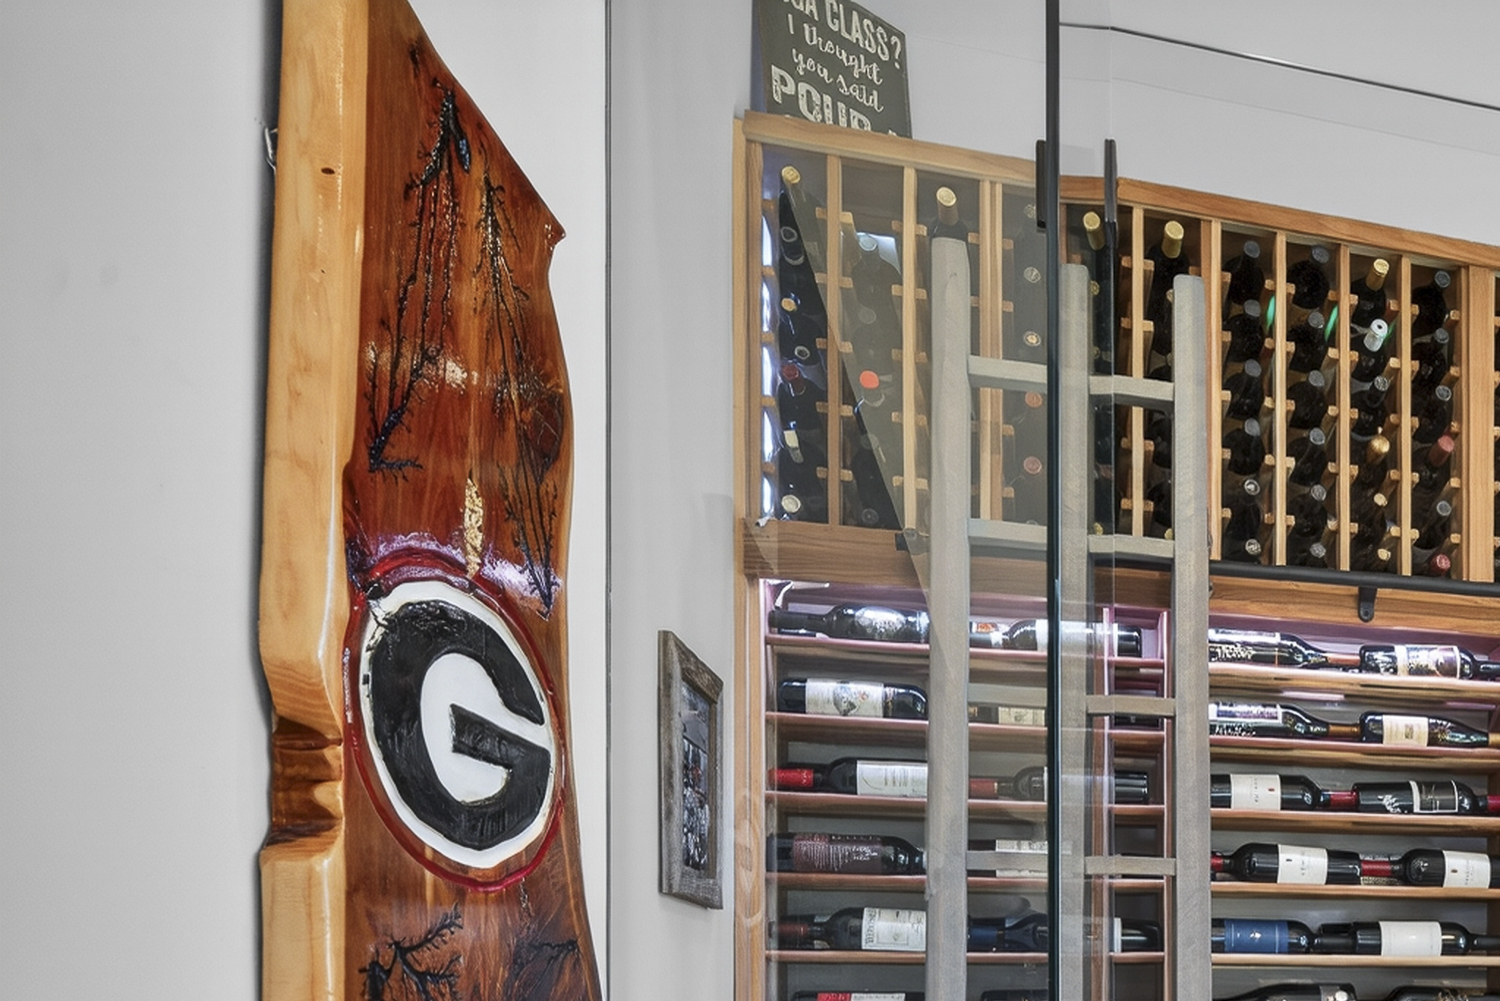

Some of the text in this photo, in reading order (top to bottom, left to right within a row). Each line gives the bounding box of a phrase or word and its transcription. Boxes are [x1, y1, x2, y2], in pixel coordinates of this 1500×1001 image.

[787, 13, 884, 86] I thought
[825, 0, 902, 70] CLASS?
[791, 48, 885, 113] you said
[370, 599, 552, 851] G
